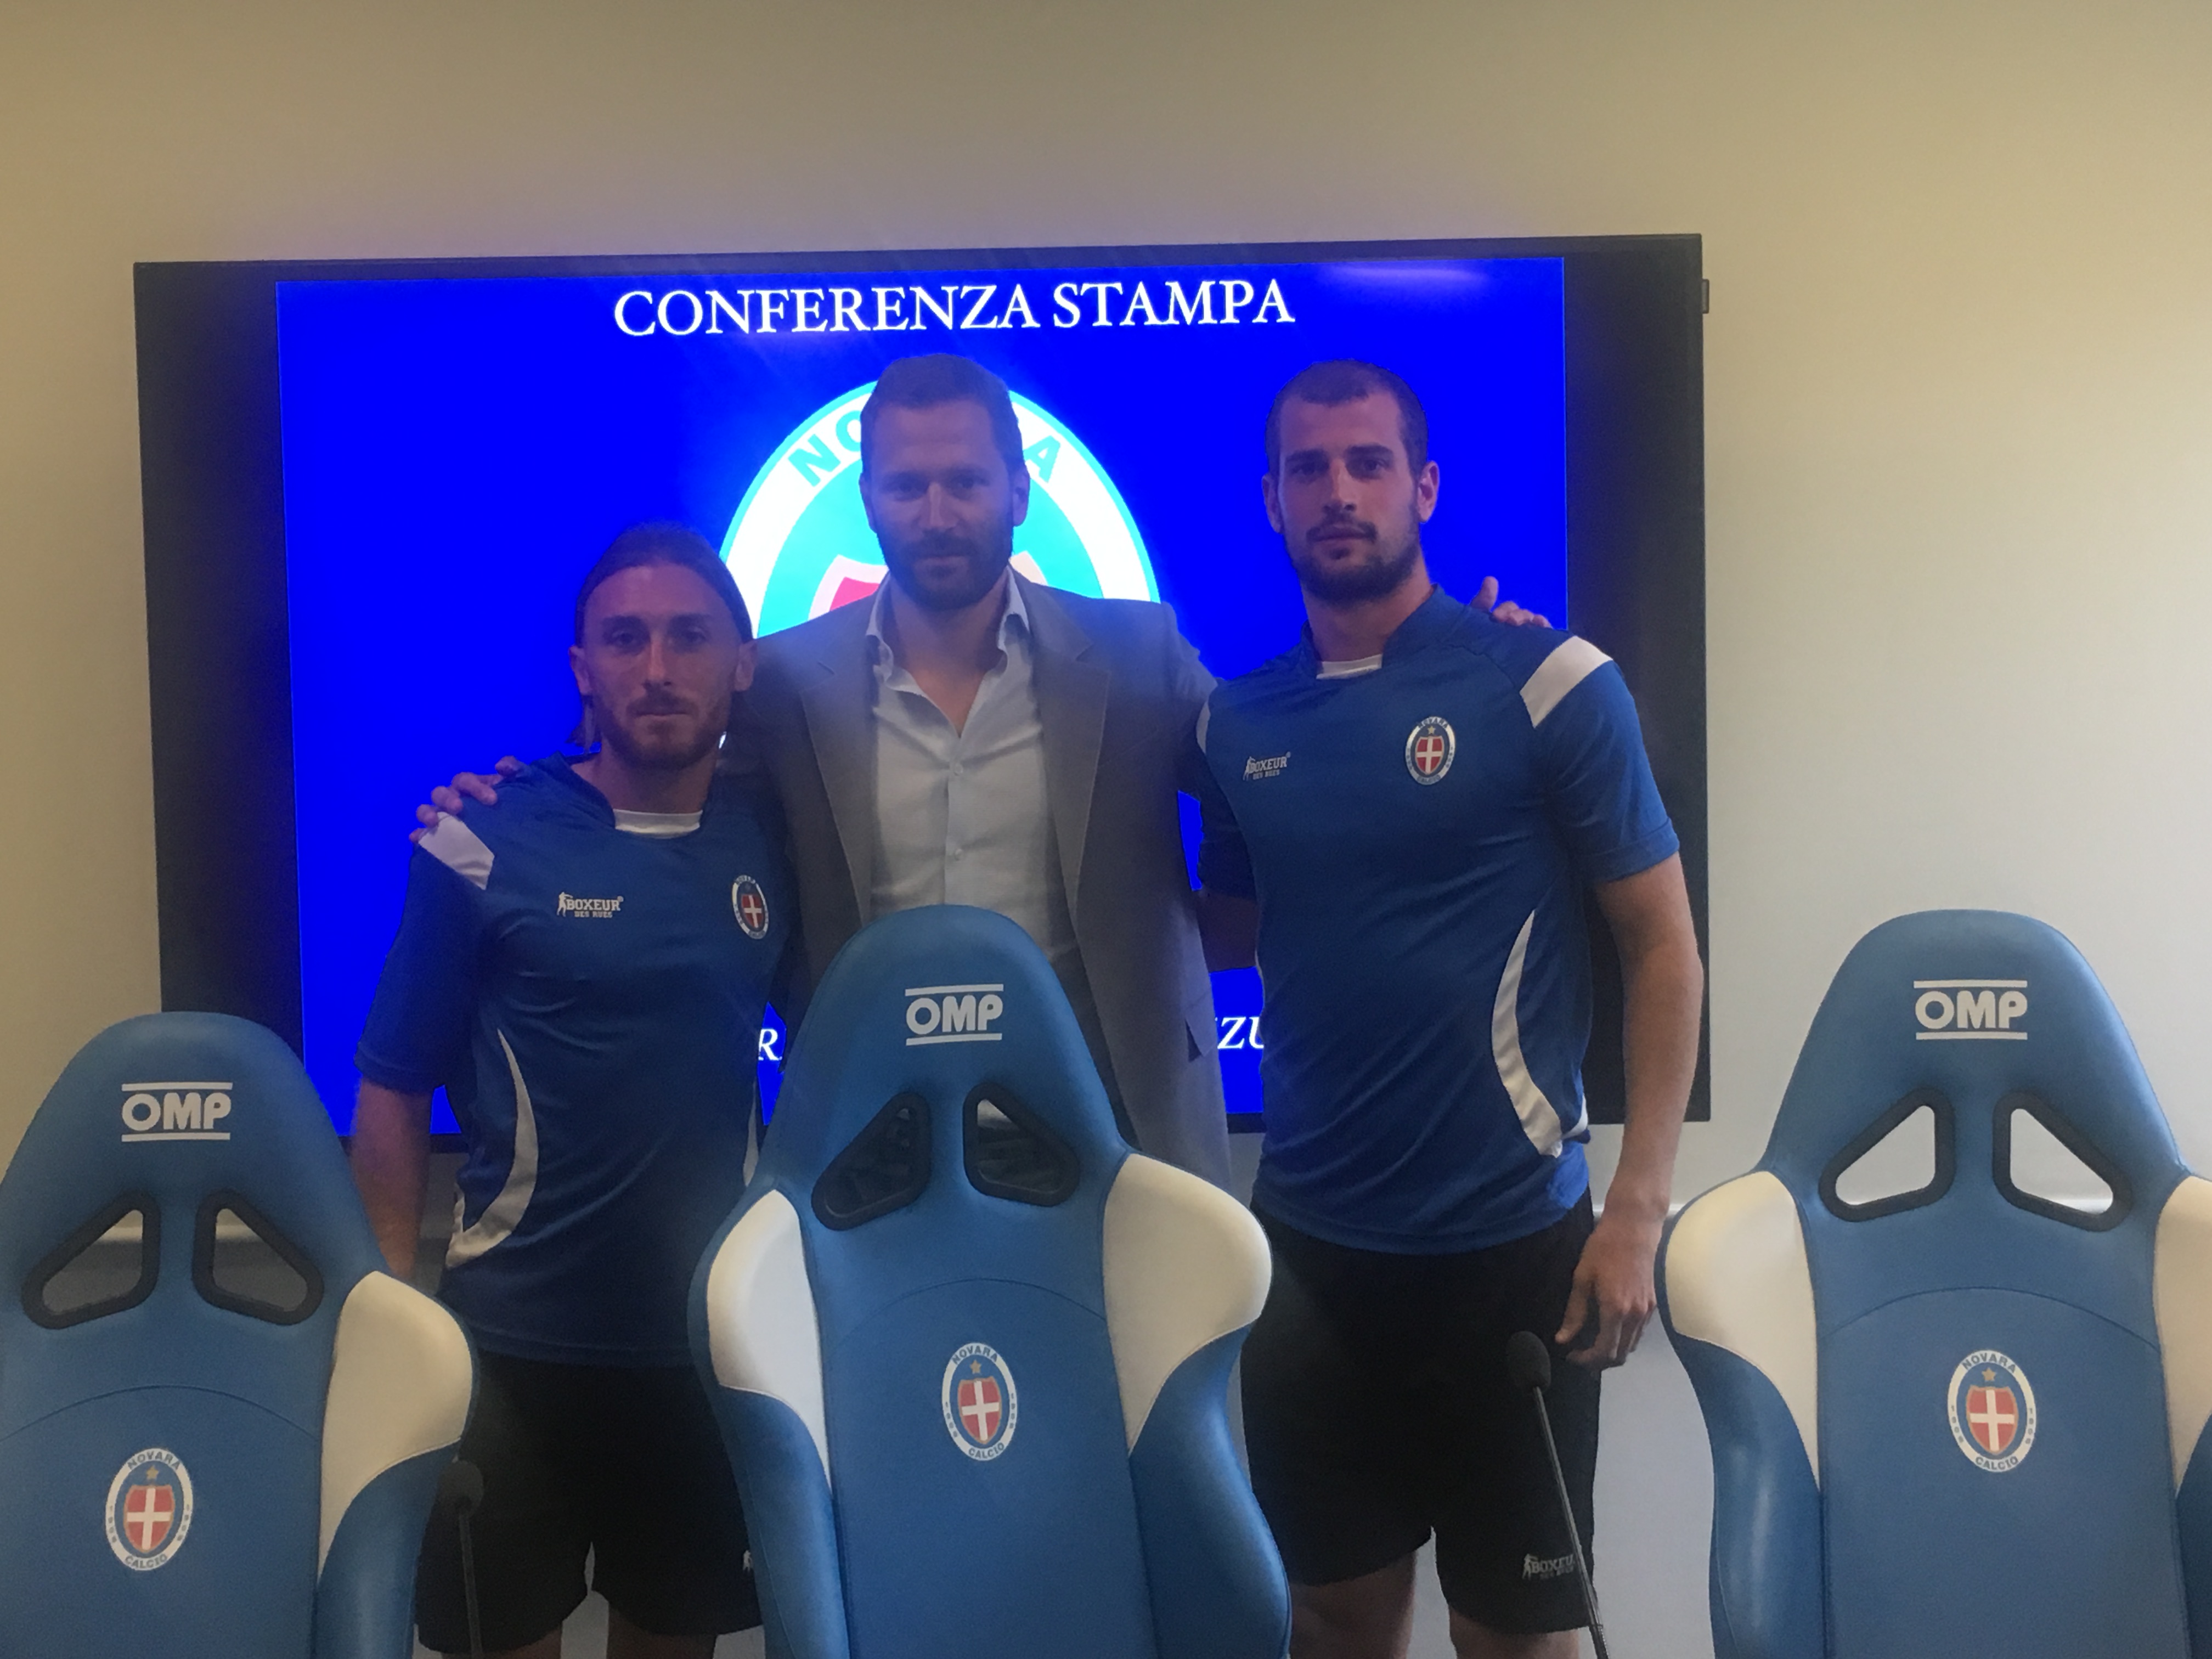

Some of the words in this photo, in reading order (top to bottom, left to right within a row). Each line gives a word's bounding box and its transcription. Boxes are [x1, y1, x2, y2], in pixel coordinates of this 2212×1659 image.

[613, 284, 1041, 337] CONFERENZA
[1053, 279, 1295, 329] STAMPA
[1248, 756, 1288, 774] BOXEUR
[566, 899, 621, 911] BOXEUR
[906, 994, 1003, 1035] OMP
[1915, 990, 2028, 1030] OMP
[121, 1091, 232, 1132] OMP
[951, 1345, 998, 1365] NOVARA
[1962, 1352, 2017, 1373] NOVARA
[968, 1442, 1005, 1459] CALCIO
[127, 1451, 180, 1471] NOVARA
[1975, 1455, 2018, 1471] CALCIO
[125, 1554, 167, 1569] CALCIO
